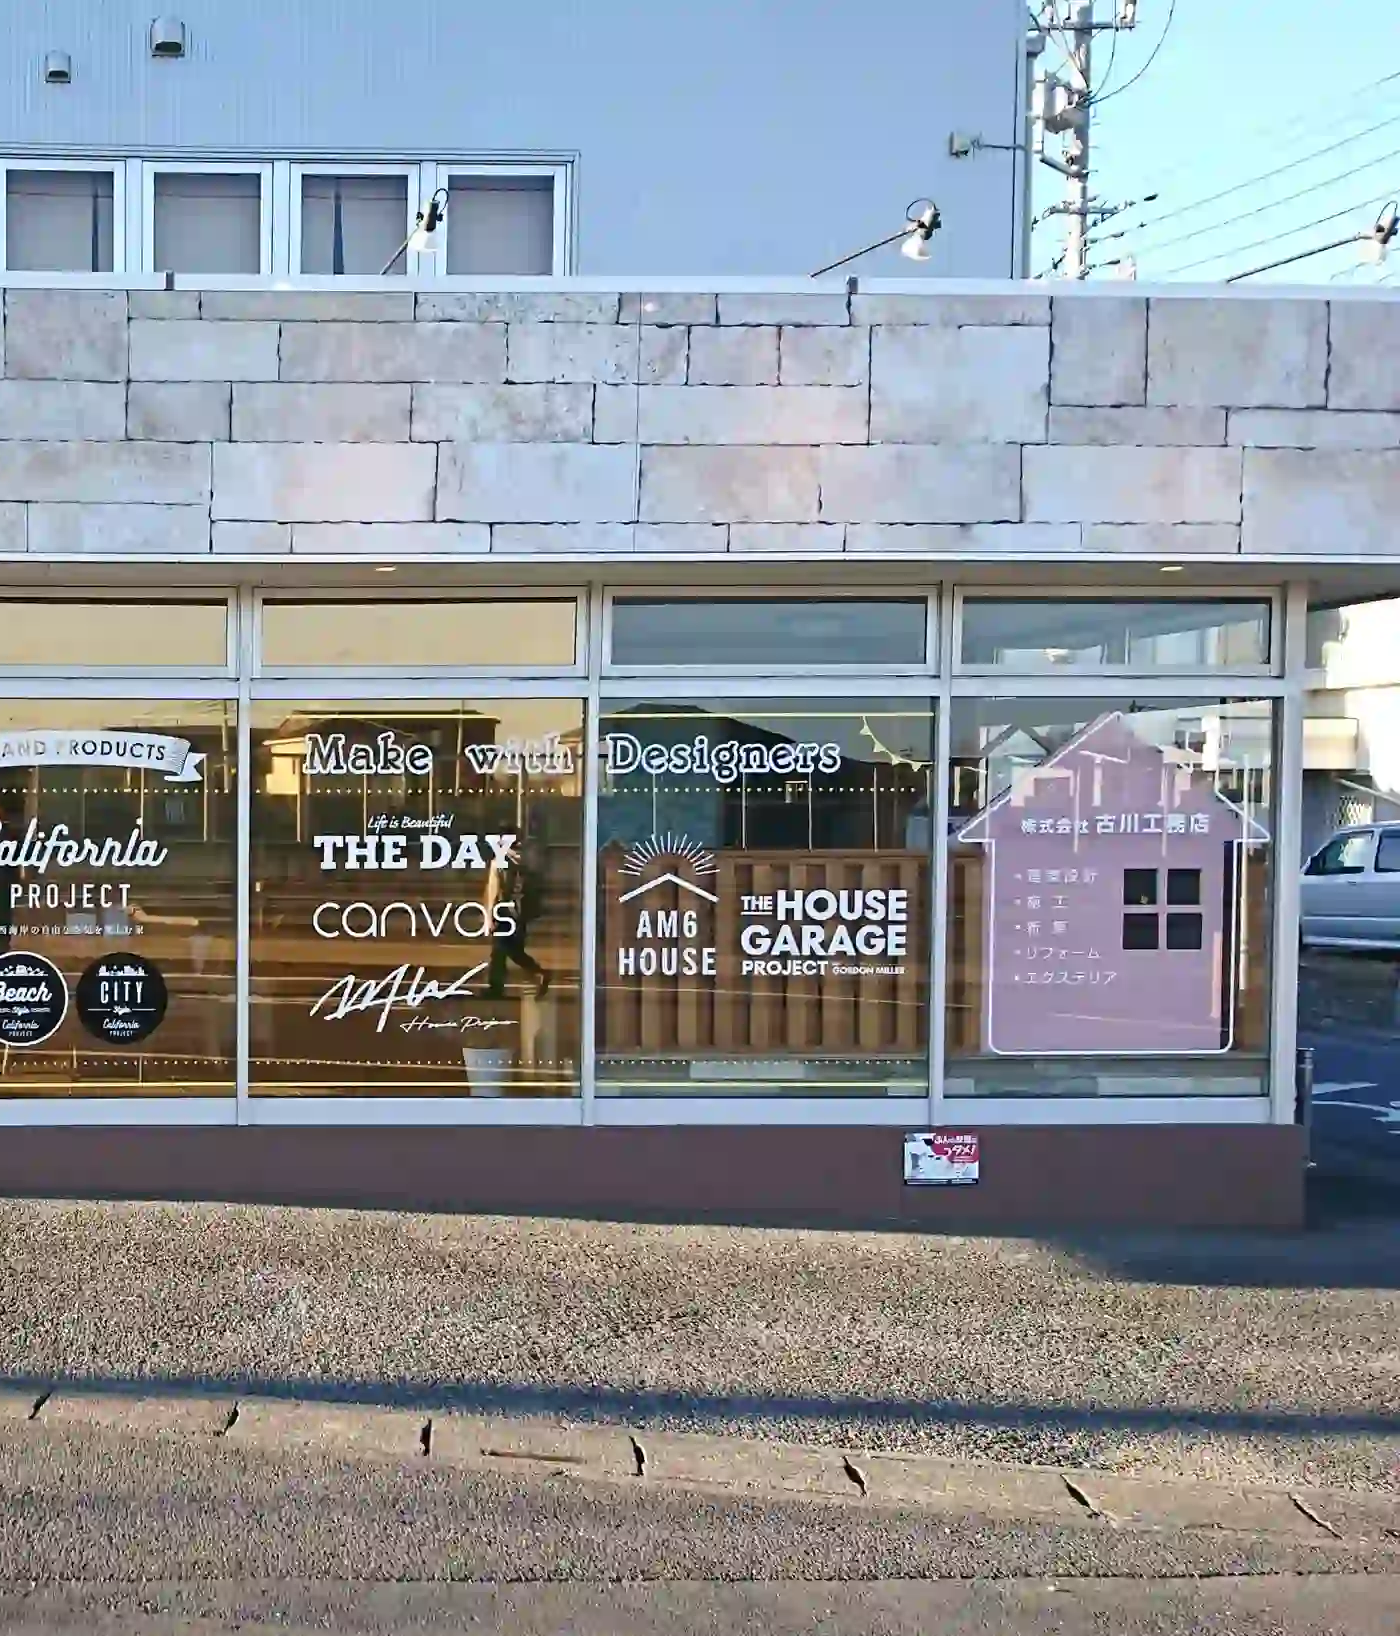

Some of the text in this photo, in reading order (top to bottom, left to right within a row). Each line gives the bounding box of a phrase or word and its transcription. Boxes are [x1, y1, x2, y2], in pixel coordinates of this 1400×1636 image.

[303, 731, 841, 783] Make with Designers
[368, 814, 455, 834] Life is Beautiful
[1020, 812, 1210, 835] 株式会社 古川工務店
[313, 835, 517, 870] THE DAY
[10, 883, 131, 909] PROJECT
[740, 890, 907, 920] THE HOUSE
[313, 901, 516, 937] canvas
[740, 925, 907, 956] GARAGE
[1027, 946, 1101, 960] リフォーム
[619, 948, 716, 976] HOUSE
[741, 960, 828, 976] PROJECT
[1024, 970, 1117, 985] エクステリア
[100, 981, 143, 1004] CITY
